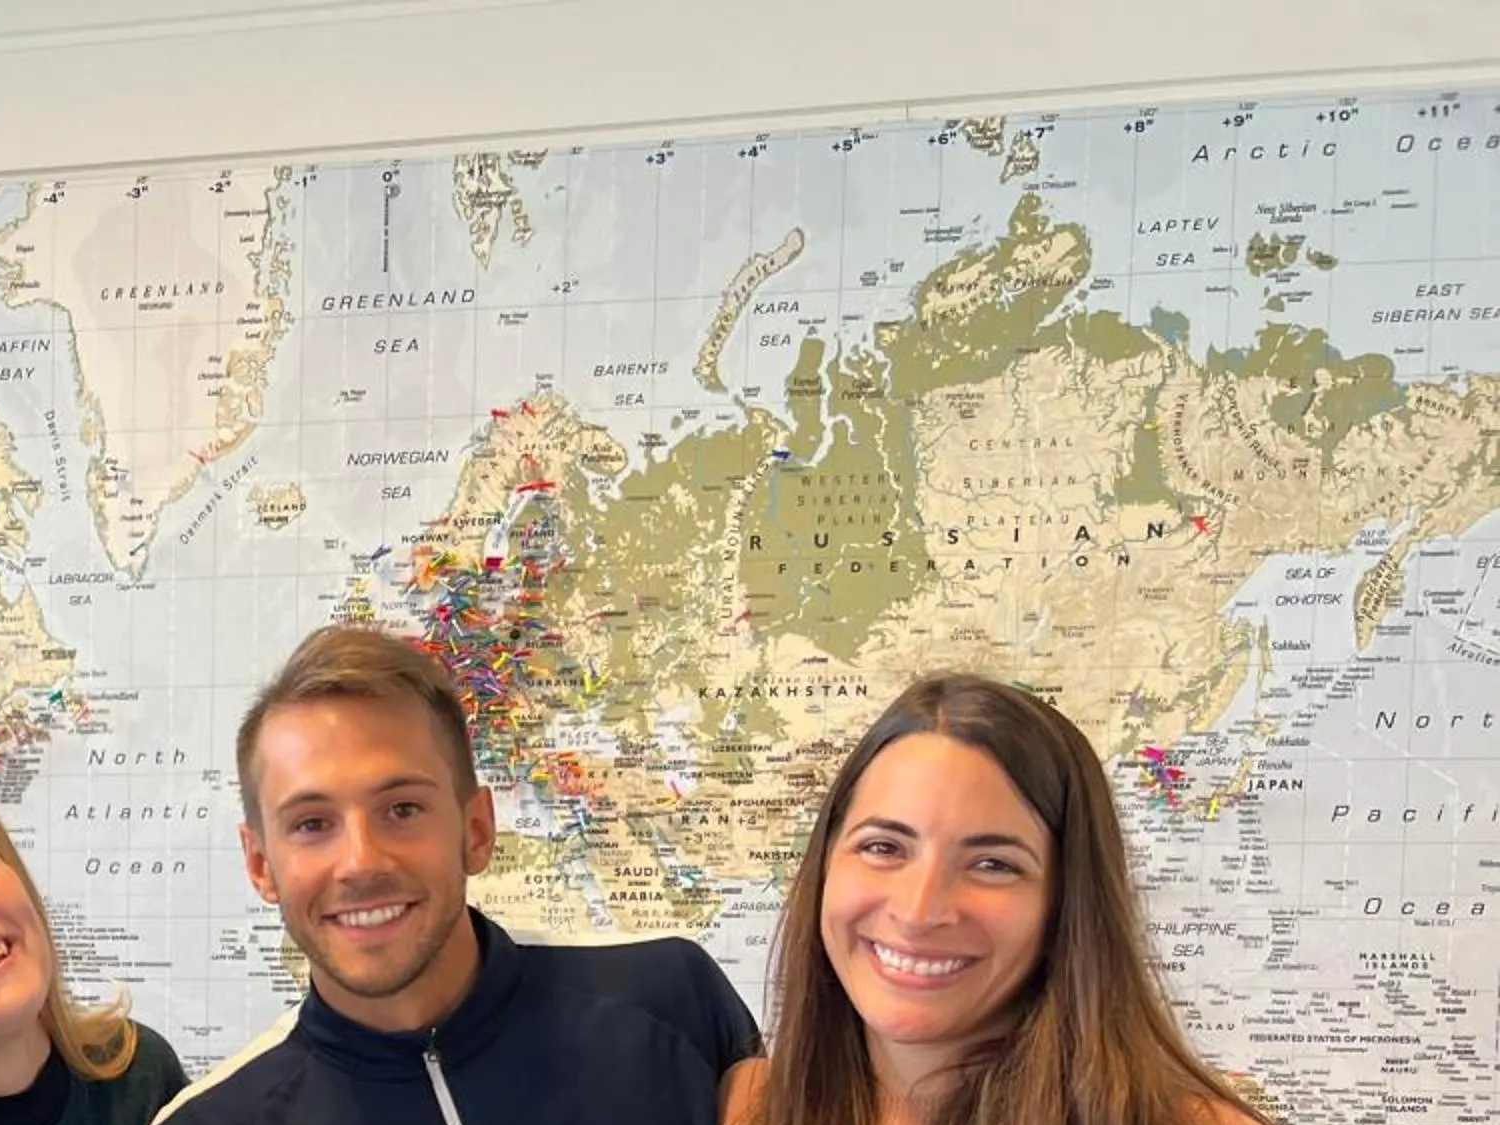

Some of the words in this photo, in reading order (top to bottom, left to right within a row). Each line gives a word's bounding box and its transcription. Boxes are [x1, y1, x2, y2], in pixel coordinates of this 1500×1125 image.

[1192, 140, 1338, 163] Arctic
[1137, 218, 1219, 234] LAPTEV
[1156, 253, 1196, 266] SEA
[101, 282, 225, 301] GREENLAND
[1416, 284, 1465, 297] EAST
[322, 289, 476, 310] GREENLAND
[753, 302, 800, 315] KARA
[1372, 308, 1461, 323] SIBERIAN
[373, 339, 420, 353] SEA
[759, 335, 791, 347] SEA
[0, 367, 35, 381] BAY
[594, 362, 669, 377] BARENTS
[615, 394, 645, 406] SEA
[969, 438, 1073, 451] CENTRAL
[347, 450, 449, 466] NORWEGIAN
[55, 457, 70, 503] Strait
[963, 476, 1077, 489] SIBERIAN
[381, 487, 412, 499] SEA
[179, 493, 223, 544] Denmark
[222, 455, 260, 491] Strait
[257, 502, 307, 513] ICELAND
[818, 514, 882, 526] PLAIN
[967, 514, 1069, 527] PLATEAU
[402, 534, 450, 543] NORWAY
[750, 522, 1164, 550] RUSSIAN
[49, 573, 114, 585] LABRADOR
[1285, 568, 1312, 579] SEA
[1316, 567, 1337, 578] OF
[69, 596, 92, 605] SEA
[722, 572, 735, 620] URAL
[1275, 594, 1343, 606] OKHOTSK
[699, 685, 868, 699] KAZAKHSTAN
[1206, 737, 1229, 746] SEA
[88, 749, 187, 766] North
[1248, 779, 1304, 791] JAPAN
[65, 805, 209, 820] Atlantic
[515, 818, 541, 828] SEA
[668, 815, 730, 825] IRAN
[85, 858, 187, 875] Ocean
[614, 868, 659, 877] SAUDI
[609, 892, 664, 900] ARABIA
[746, 936, 768, 946] SEA
[1171, 945, 1205, 957] SEA
[1359, 952, 1436, 960] MARSHALL
[1365, 961, 1429, 970] ISLANDS
[1187, 1022, 1236, 1031] PALAU
[1250, 1034, 1304, 1043] FEDERATED
[1306, 1034, 1342, 1043] STATES
[1344, 1035, 1357, 1043] OF
[1360, 1035, 1421, 1045] MICRONESIA
[1382, 1096, 1433, 1105] SOLOMON
